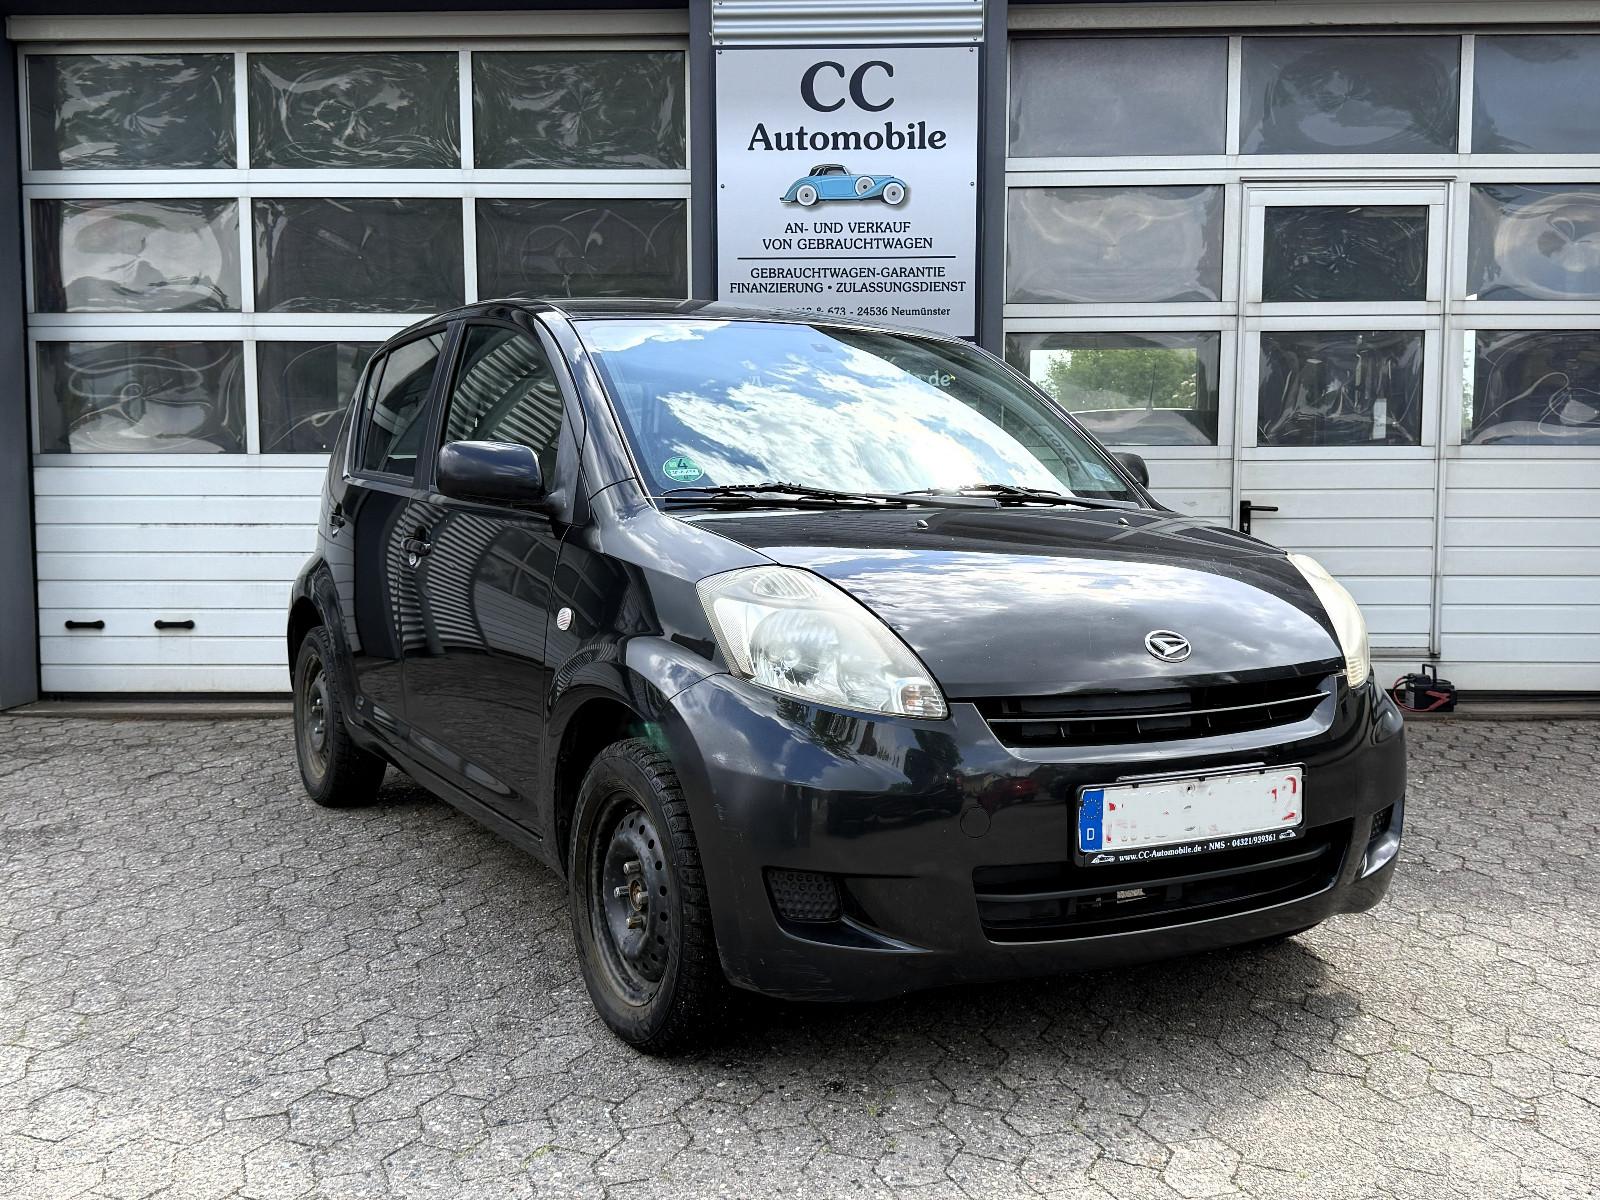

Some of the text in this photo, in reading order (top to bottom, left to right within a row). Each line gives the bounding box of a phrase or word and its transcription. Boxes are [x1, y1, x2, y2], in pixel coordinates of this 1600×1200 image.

[800, 60, 895, 112] CC
[747, 121, 947, 151] Automobile
[784, 221, 911, 234] AN- UND VERKAUF
[762, 237, 933, 250] VON GEBRAUCHTWAGEN
[750, 266, 946, 279] GEBRAUCHTWAGEN-GARANTIE
[729, 281, 966, 294] FINANZIERUNG ZULASSUNGSDIENST
[857, 306, 888, 316] 24536
[891, 306, 951, 316] Neumünster
[677, 458, 688, 469] 4
[1086, 827, 1095, 841] D
[1119, 833, 1277, 862] www.CC-Automobile.de NMS 04321/939361
